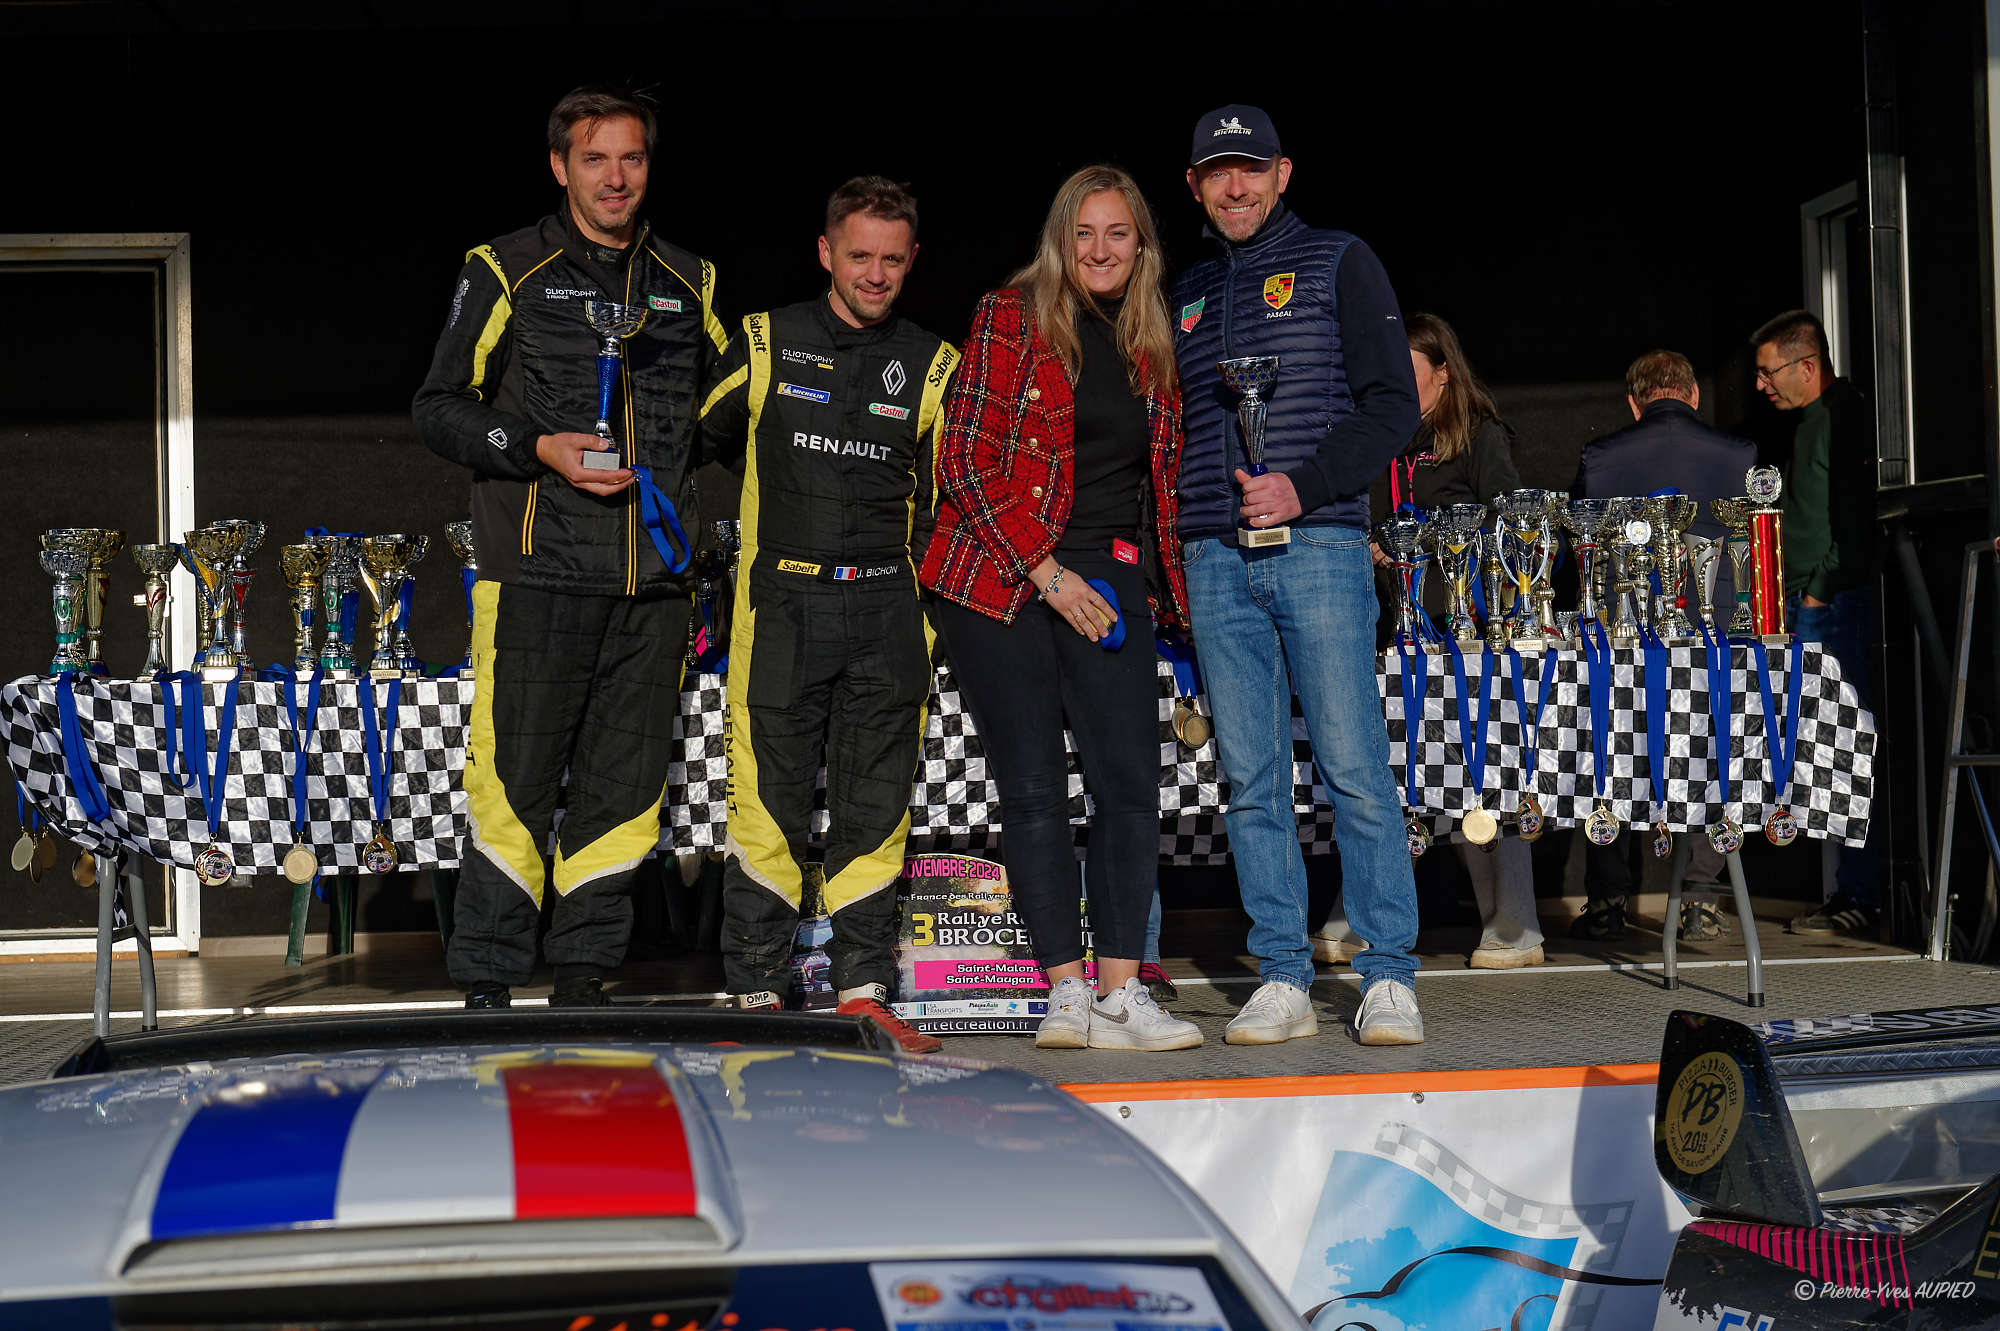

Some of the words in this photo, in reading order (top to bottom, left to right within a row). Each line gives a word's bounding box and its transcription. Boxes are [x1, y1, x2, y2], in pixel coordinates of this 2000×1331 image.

[1213, 128, 1252, 137] MICHELIN
[545, 288, 597, 297] CLIOTROPHY
[1266, 310, 1292, 319] PASCAL
[749, 315, 767, 353] Sabelt
[782, 348, 834, 365] CLIOTROPHY
[929, 349, 954, 387] Sabelt
[792, 388, 825, 400] MICHELIN
[879, 405, 905, 419] Castrol
[793, 431, 892, 461] RENAULT
[782, 561, 815, 574] Sabelt
[856, 569, 864, 578] J.
[866, 565, 898, 578] BICHON
[902, 858, 966, 879] OVEMBRE
[968, 860, 1000, 880] 2024
[911, 893, 948, 901] France
[949, 892, 967, 900] des
[968, 892, 1006, 902] Rallyes
[937, 913, 1002, 928] Rallye
[939, 928, 1028, 945] BROCE
[946, 974, 1034, 985] Saint-Maugan
[747, 993, 769, 1004] OMP
[1718, 1062, 1737, 1106] BURGER
[1682, 1080, 1726, 1125] PB
